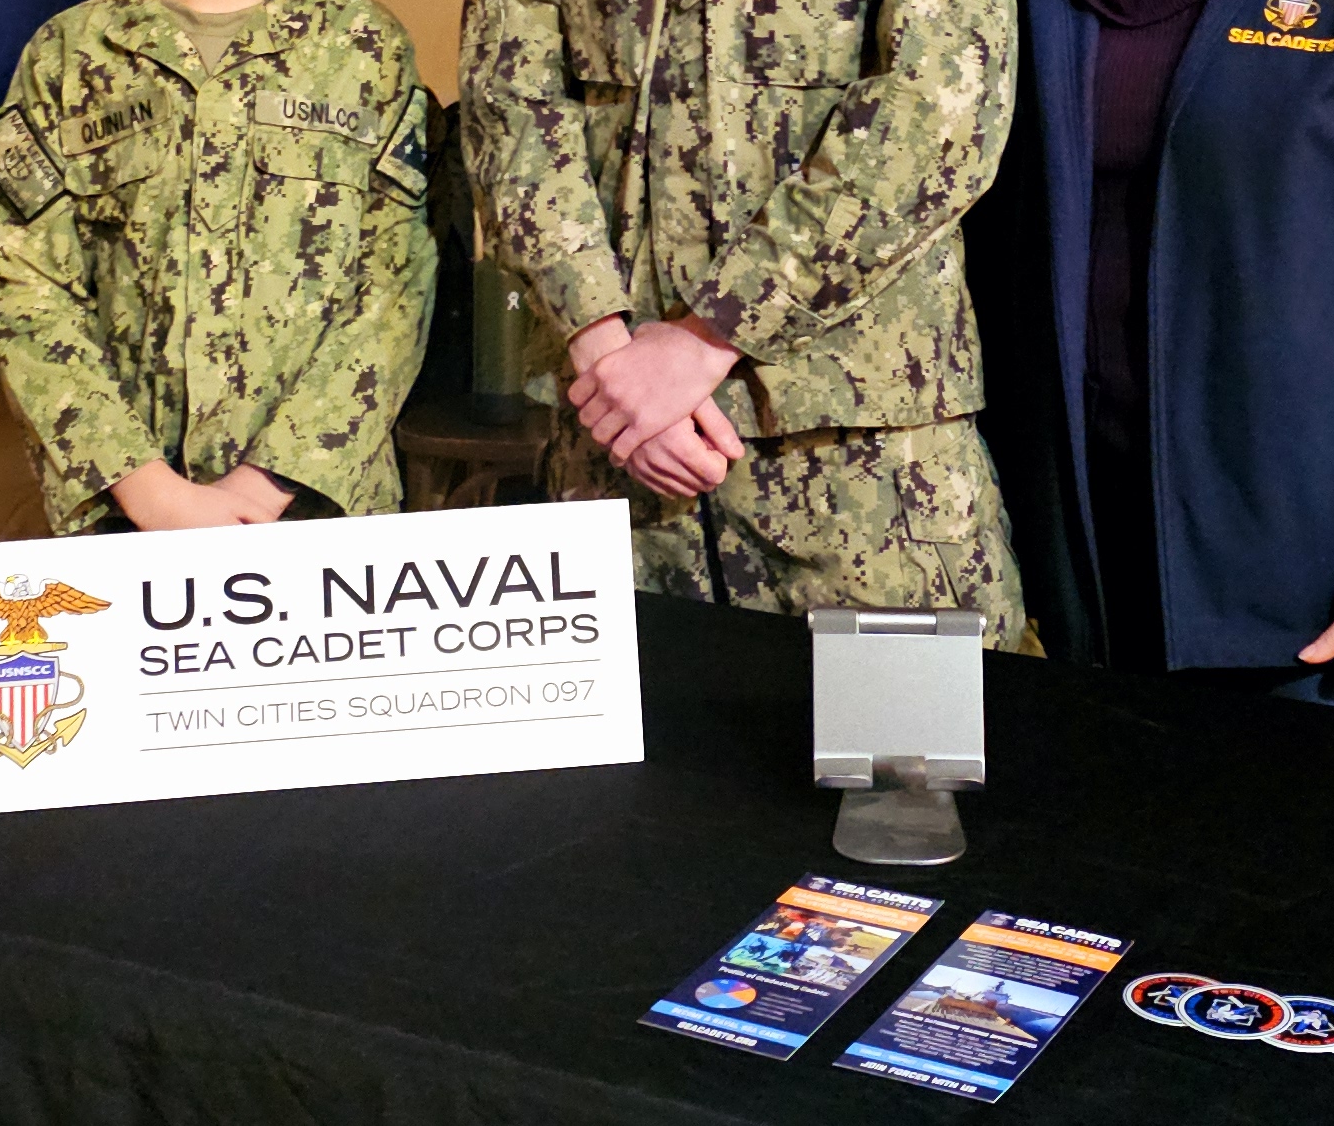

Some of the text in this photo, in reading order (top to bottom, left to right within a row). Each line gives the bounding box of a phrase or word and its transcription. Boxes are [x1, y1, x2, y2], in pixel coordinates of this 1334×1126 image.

[1227, 26, 1266, 45] SEA
[80, 98, 154, 144] QUINLAN
[281, 98, 361, 132] USNLCC
[141, 551, 597, 631] U.S. NAVAL
[139, 613, 600, 677] SEA CADET CORPS
[146, 680, 597, 733] TWIN CITIES SQUADRON 097
[832, 882, 866, 896] SEA
[866, 889, 934, 909] CADETS
[1015, 918, 1050, 932] SEA
[1050, 925, 1122, 948] CADETS
[859, 1060, 888, 1073] JOIN
[931, 1076, 960, 1090] WITH
